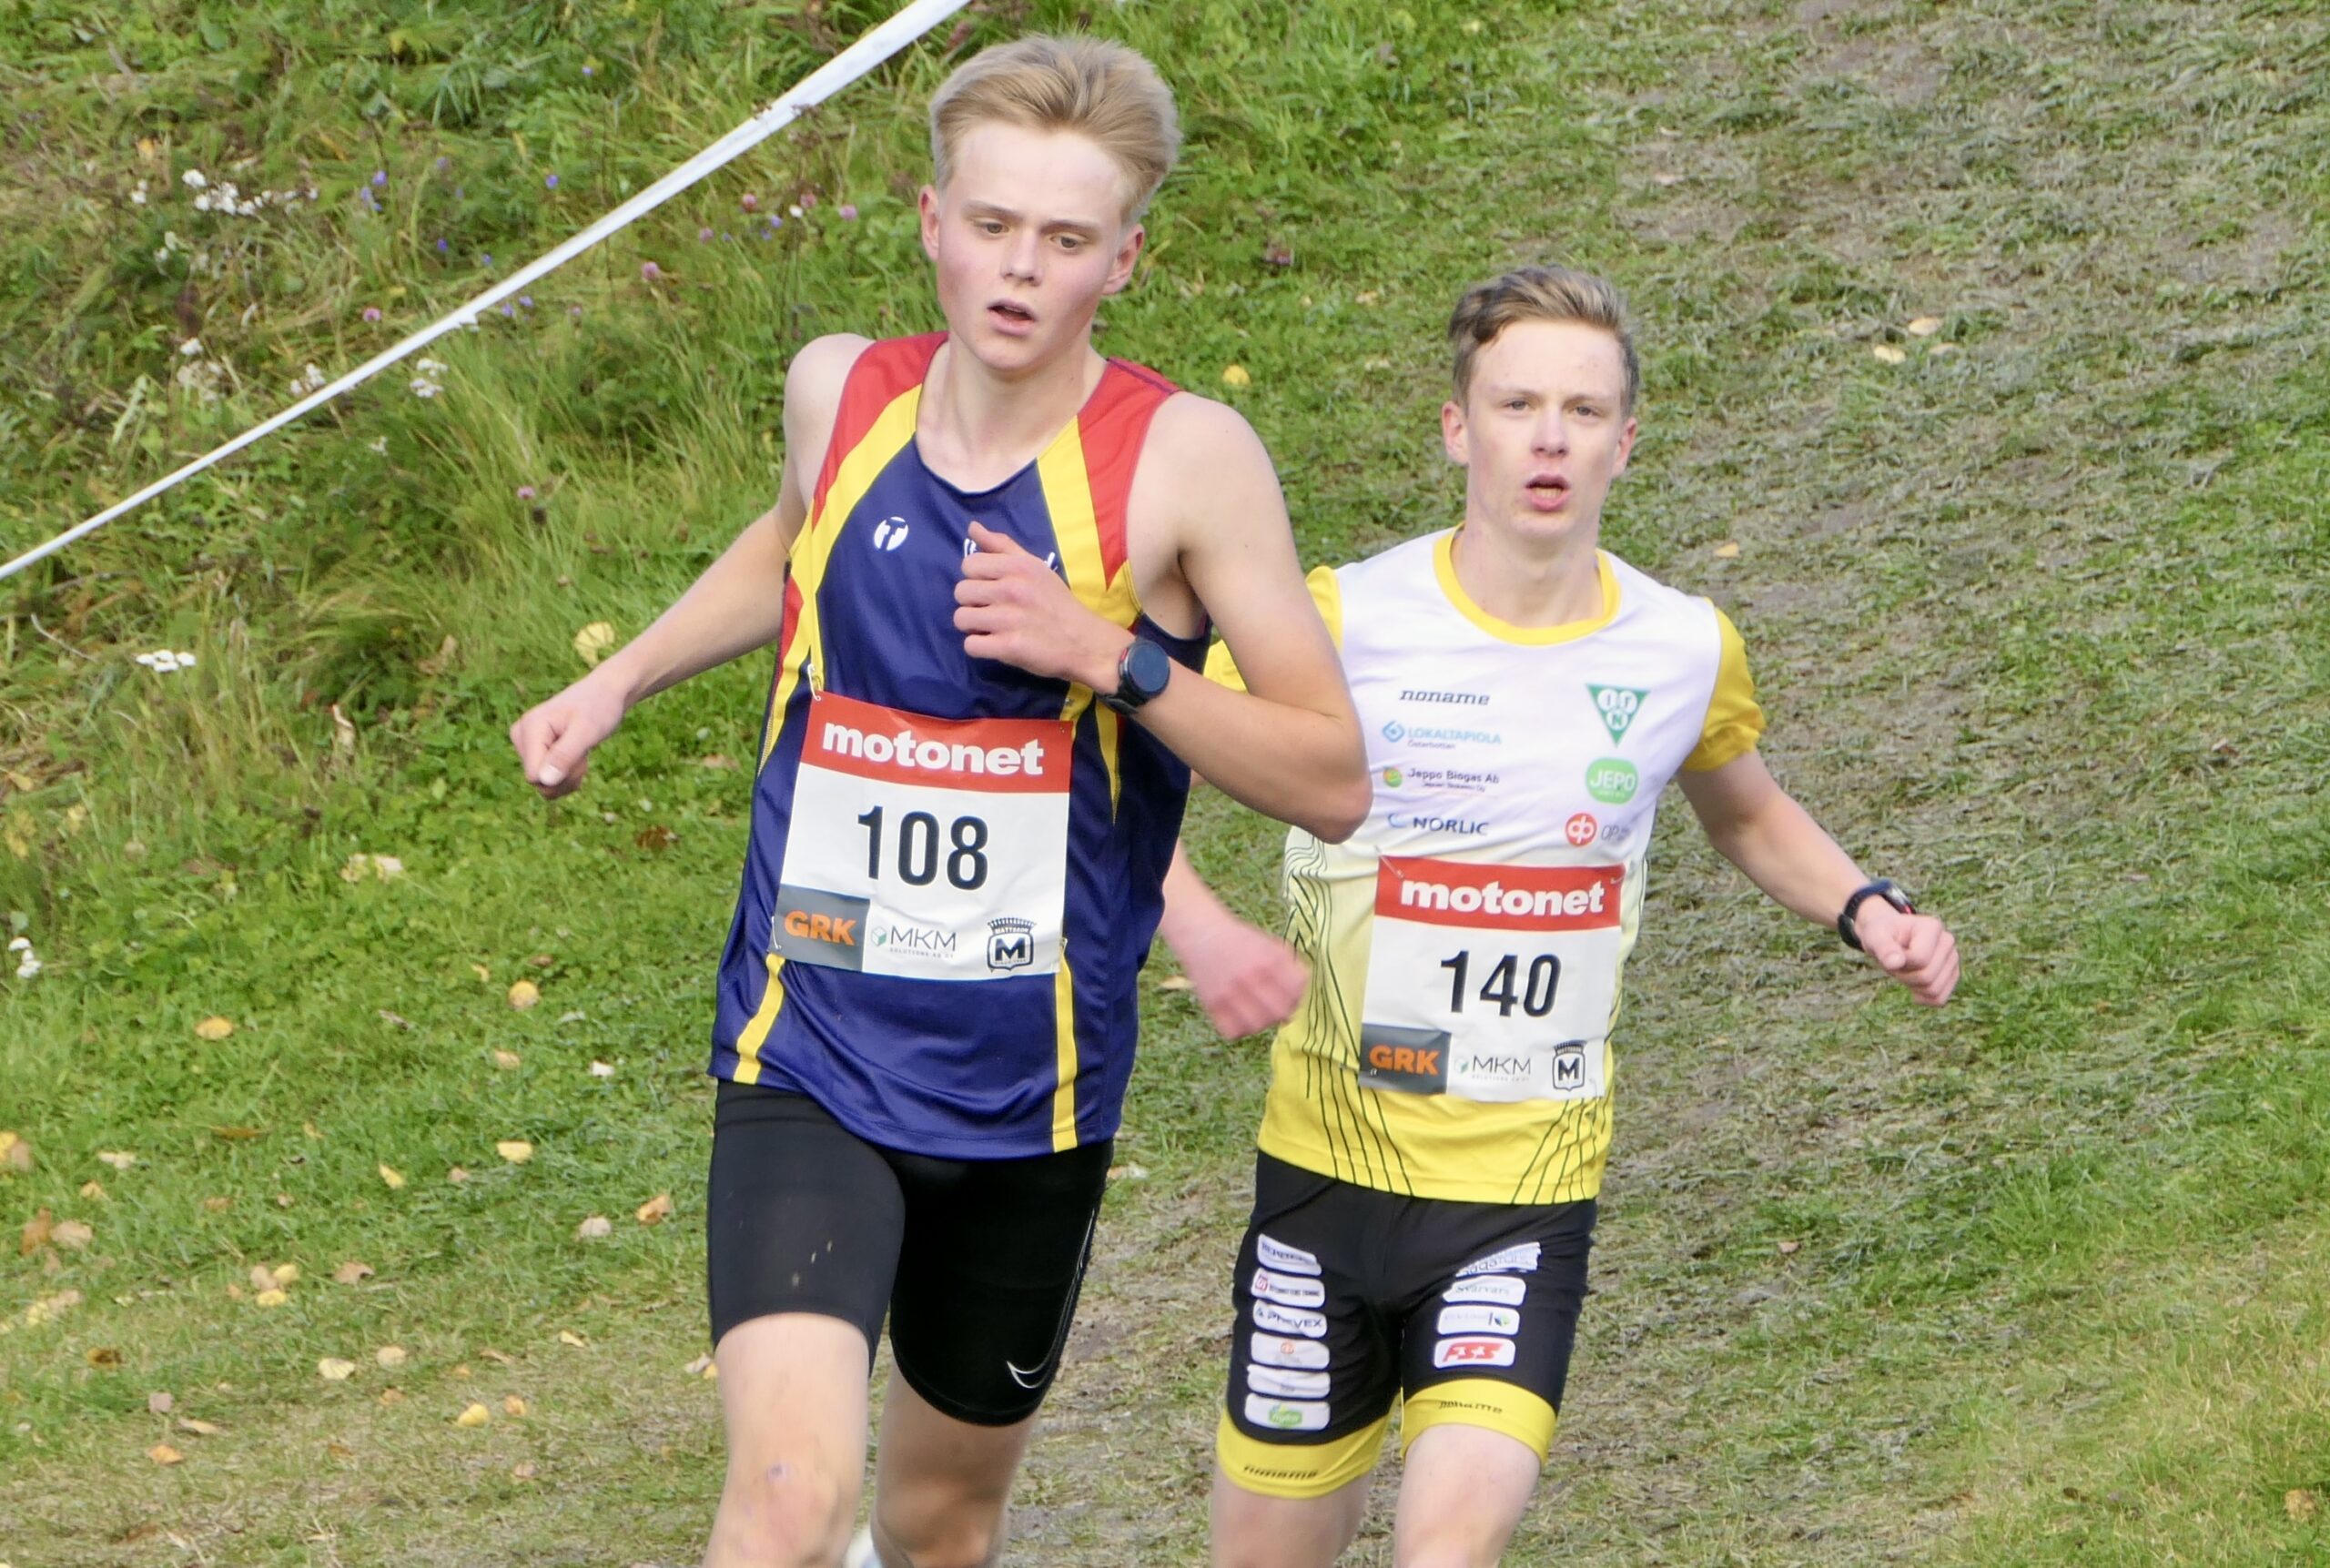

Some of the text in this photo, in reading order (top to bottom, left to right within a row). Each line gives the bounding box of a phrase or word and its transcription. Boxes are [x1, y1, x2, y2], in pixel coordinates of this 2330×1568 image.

[1400, 690, 1490, 705] noname
[823, 722, 1044, 775] motonet
[1408, 767, 1500, 784] Jeppo Biogas Ab
[1590, 769, 1636, 792] JEPO
[1413, 816, 1490, 836] NORLIC
[857, 804, 988, 890] 108
[1401, 880, 1605, 916] motonet
[784, 910, 856, 946] GRK
[890, 925, 957, 952] MKM
[994, 937, 1027, 961] M
[1441, 950, 1562, 1017] 140
[1369, 1045, 1440, 1076] GRK
[1473, 1055, 1531, 1076] MKM
[1557, 1057, 1581, 1081] M
